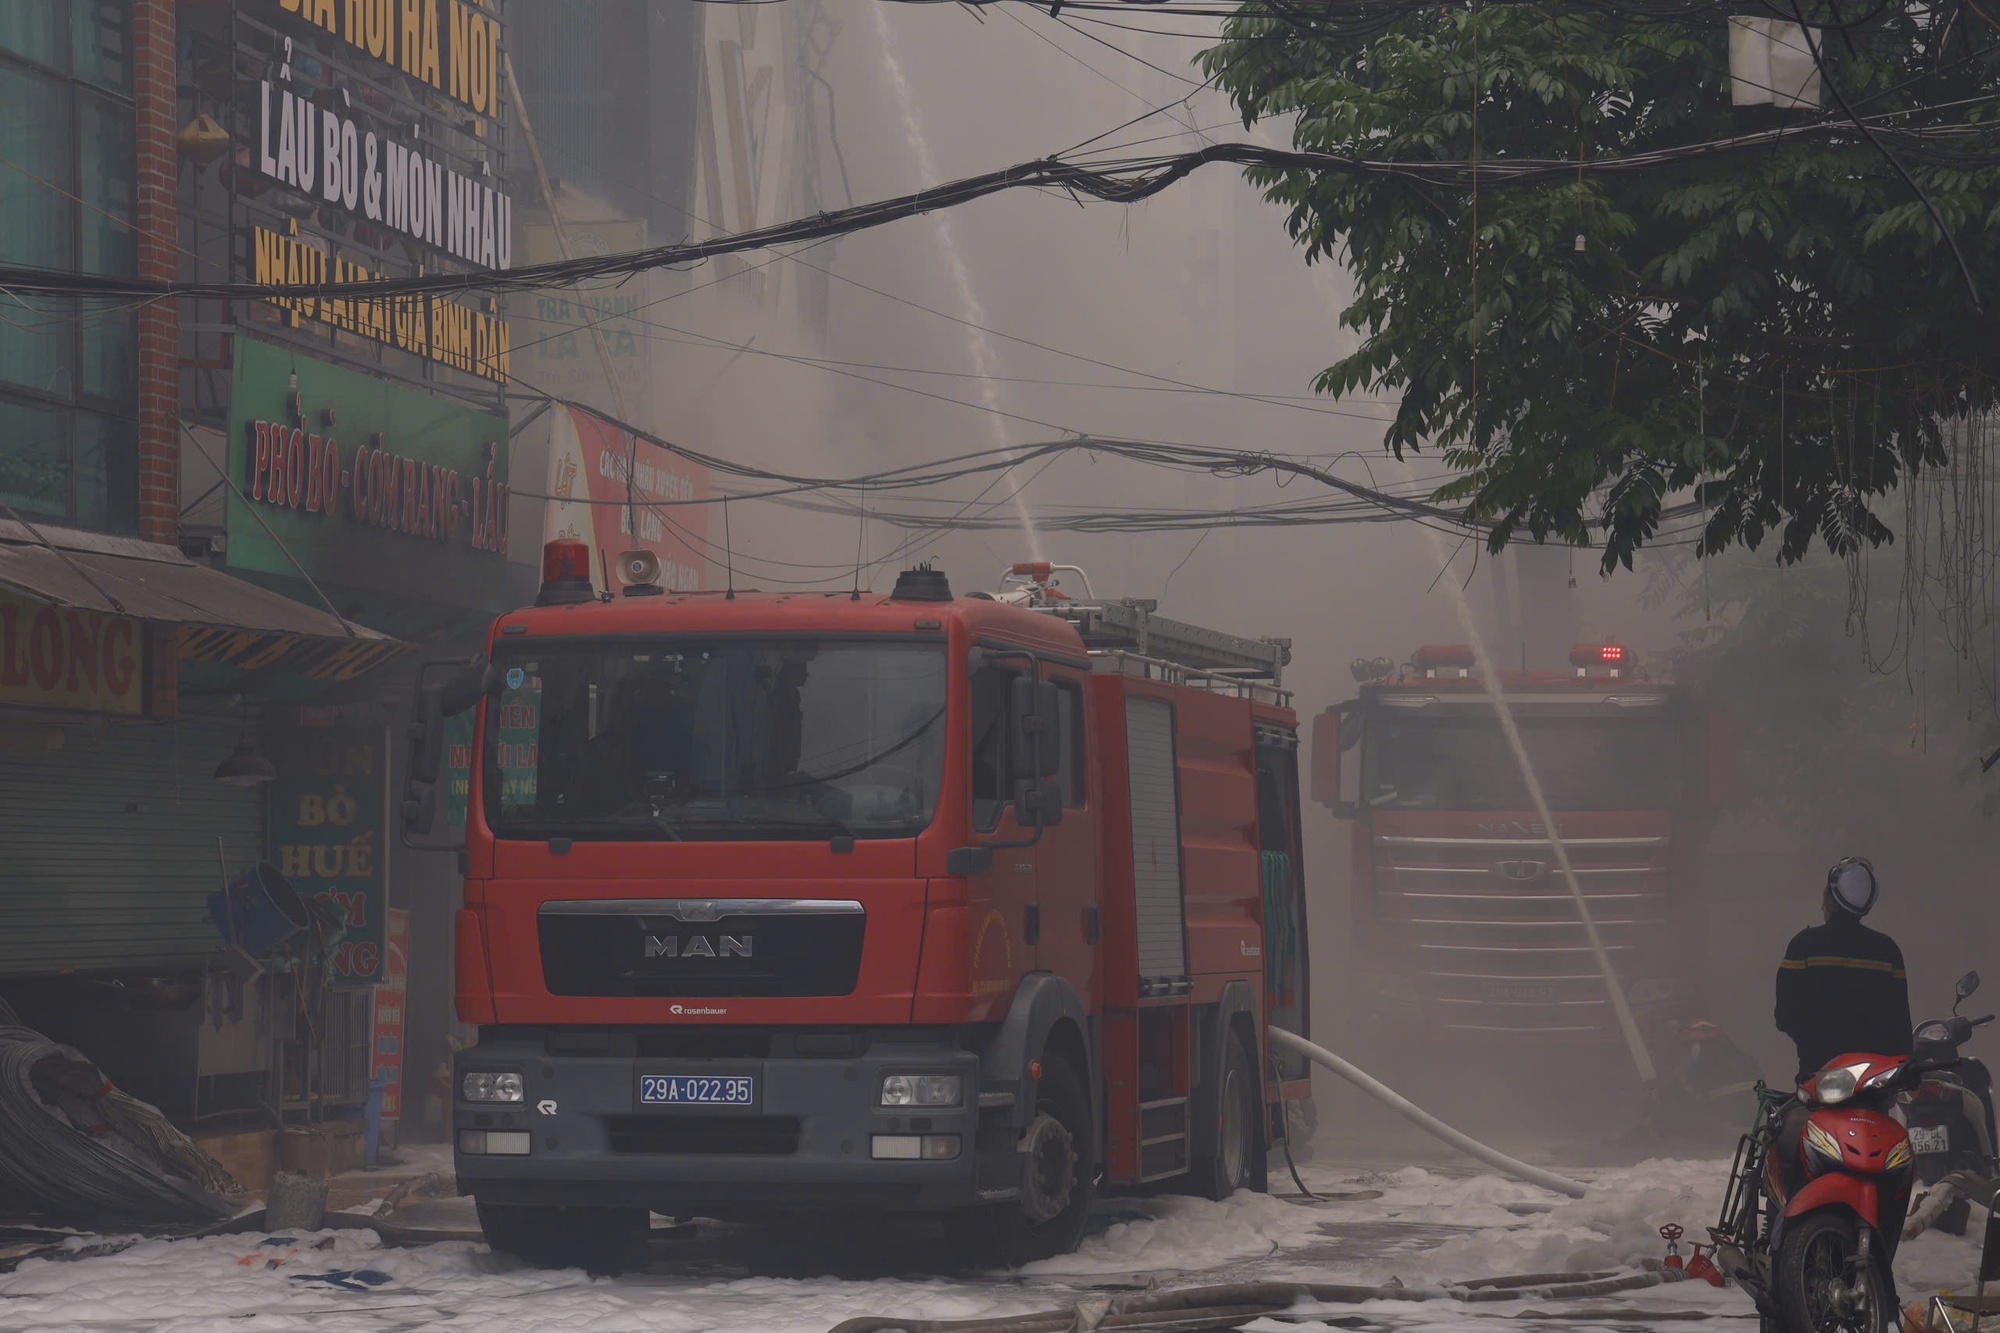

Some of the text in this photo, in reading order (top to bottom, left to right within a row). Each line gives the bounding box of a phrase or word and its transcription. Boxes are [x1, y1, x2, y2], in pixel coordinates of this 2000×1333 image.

[261, 36, 315, 193] LẨU
[323, 88, 358, 211] BÒ
[363, 131, 383, 221] &
[386, 123, 442, 248] MÓN
[255, 218, 319, 328] NHẬU
[477, 297, 510, 384] DÂN
[252, 391, 307, 509] PHỞ
[354, 432, 400, 532] CƠM
[402, 457, 459, 542] RANG
[471, 442, 511, 554] LẨU
[0, 602, 136, 697] LONG
[500, 698, 536, 729] YỂN
[296, 781, 358, 826] BÒ
[280, 828, 375, 878] HUẾ
[645, 936, 753, 957] MAN
[684, 1006, 728, 1016] rosenbauer
[644, 1079, 749, 1101] 29A-022.95
